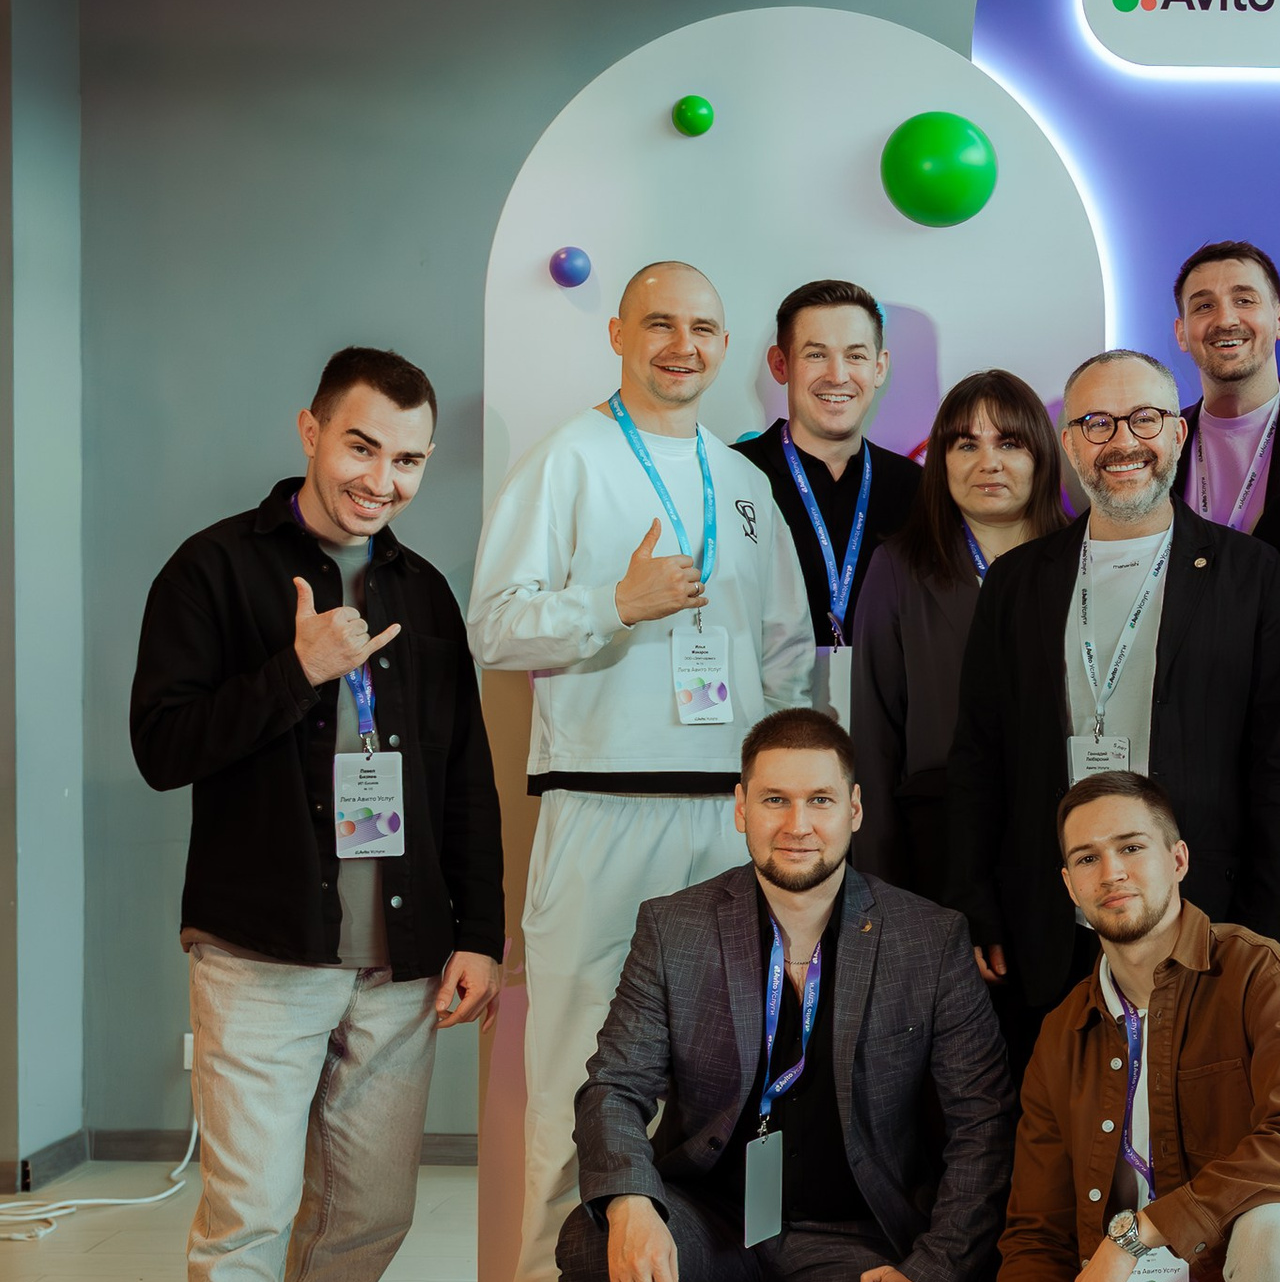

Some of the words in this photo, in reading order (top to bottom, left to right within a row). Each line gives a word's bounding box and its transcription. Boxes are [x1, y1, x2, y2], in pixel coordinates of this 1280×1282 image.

[770, 989, 778, 1016] Услуги
[806, 982, 814, 1008] Услуги
[1130, 1013, 1138, 1040] Услуги
[778, 1073, 793, 1089] Avito
